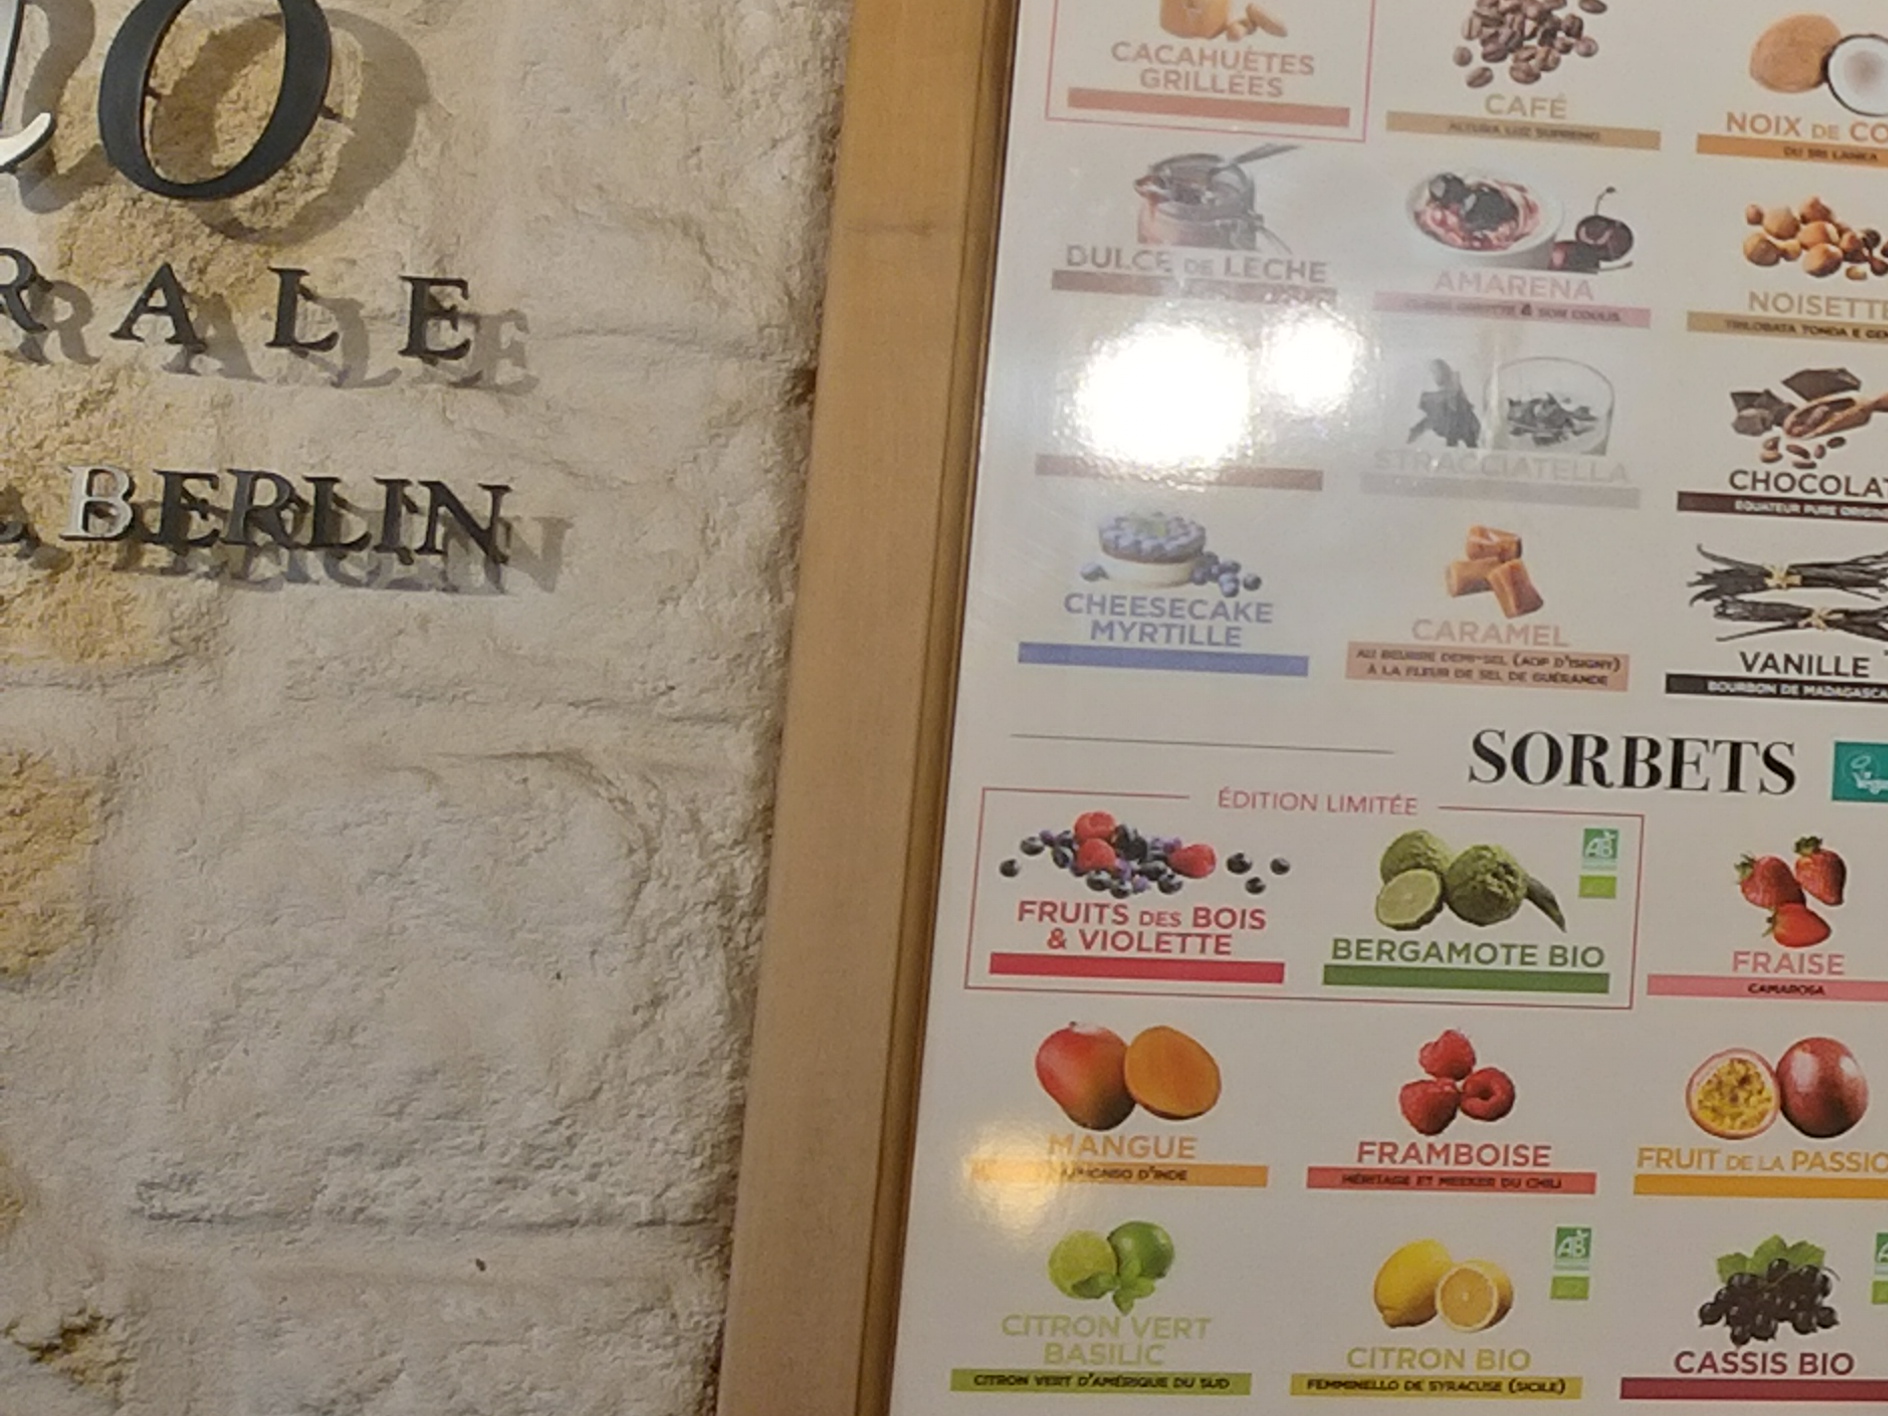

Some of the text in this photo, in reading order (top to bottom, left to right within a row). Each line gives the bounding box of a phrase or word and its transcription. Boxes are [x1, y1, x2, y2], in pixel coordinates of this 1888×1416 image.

[1110, 40, 1316, 76] CACAHUÈTES
[1139, 66, 1284, 99] GRILLÉES
[1484, 91, 1568, 120] CAFÉ
[1725, 110, 1801, 139] NOIX
[1810, 121, 1841, 141] DE
[1065, 244, 1327, 284] DULCE DE LECHE
[1434, 268, 1596, 302] AMARENA
[1372, 446, 1631, 484] STRACCIATELLA
[60, 464, 512, 566] BERLIN
[1063, 591, 1274, 625] CHEESECAKE
[1090, 620, 1242, 650] MYRTILLE
[1411, 618, 1570, 650] CARAMEL
[1738, 650, 1871, 679] VANILLE
[1467, 726, 1797, 796] SORBETS
[1217, 786, 1418, 816] ÉDITION LIMITÉE
[1016, 899, 1267, 931] FRUITS DES BOIS
[1046, 927, 1233, 957] & VIOLETTE
[1331, 937, 1606, 969] BERGAMOTE BIO
[1731, 950, 1846, 977] FRAISE
[1046, 1133, 1198, 1161] MANGUE
[1356, 1141, 1553, 1169] FRAMBOISE
[1636, 1146, 1721, 1172] FRUIT
[1728, 1153, 1754, 1172] DE
[1759, 1154, 1785, 1173] LA
[1000, 1312, 1213, 1343] CITRON VERT
[1042, 1341, 1168, 1369] BASILIC
[1347, 1346, 1532, 1372] CITRON BIO
[1673, 1349, 1856, 1376] CASSIS BIO
